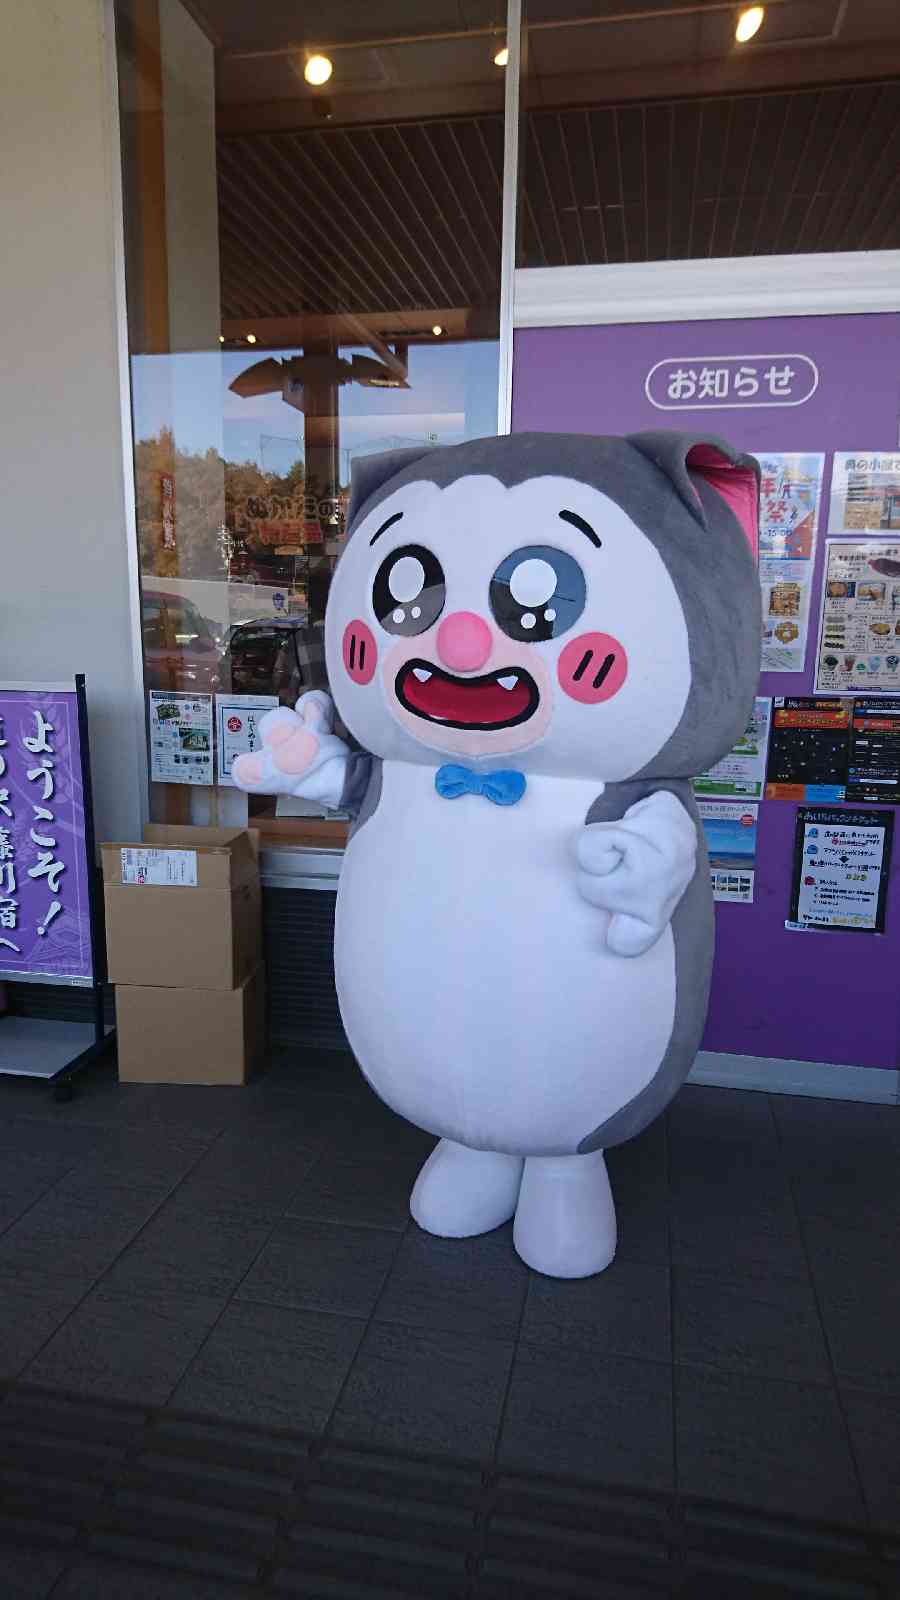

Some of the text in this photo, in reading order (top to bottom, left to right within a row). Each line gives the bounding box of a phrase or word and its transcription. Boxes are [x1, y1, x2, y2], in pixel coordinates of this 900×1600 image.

[667, 365, 795, 399] お知らせ
[22, 710, 65, 936] ようこそ！
